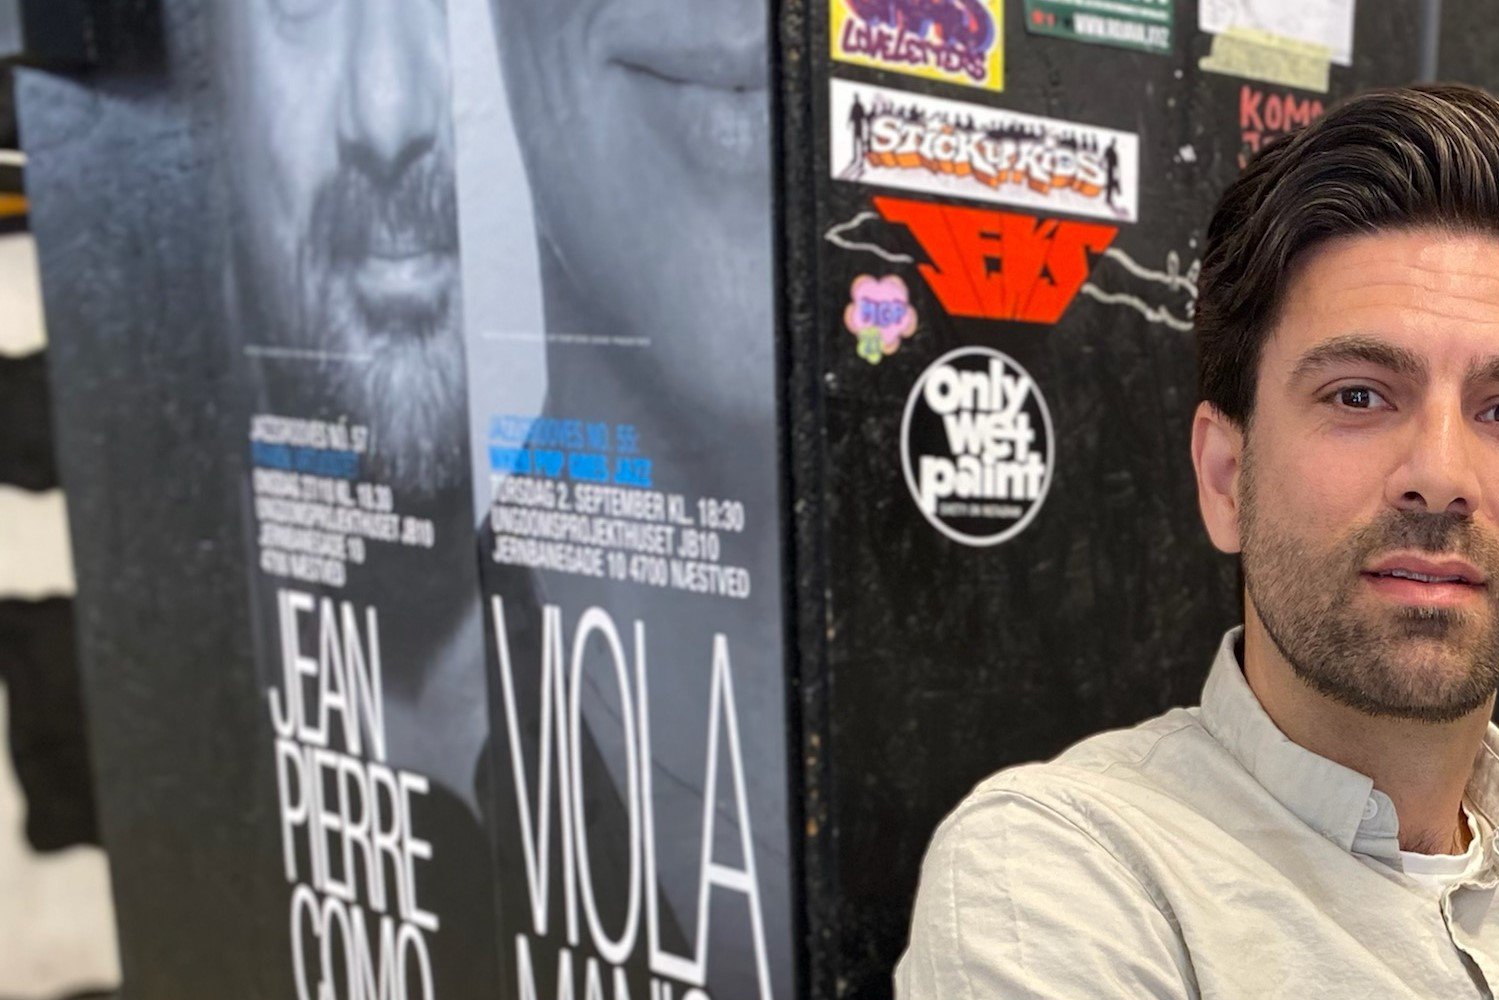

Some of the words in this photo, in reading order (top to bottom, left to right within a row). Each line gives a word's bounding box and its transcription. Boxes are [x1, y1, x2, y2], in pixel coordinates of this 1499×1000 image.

[923, 357, 1031, 424] only
[943, 411, 1036, 465] wet
[574, 482, 666, 522] SEPTEMBER
[667, 493, 695, 527] KL.
[697, 496, 746, 533] 18:30
[918, 452, 1046, 517] paint
[608, 548, 628, 580] 10
[630, 552, 669, 588] 4700
[677, 526, 721, 562] JB10
[269, 589, 386, 763] JEAN
[276, 736, 439, 931] PIERRE
